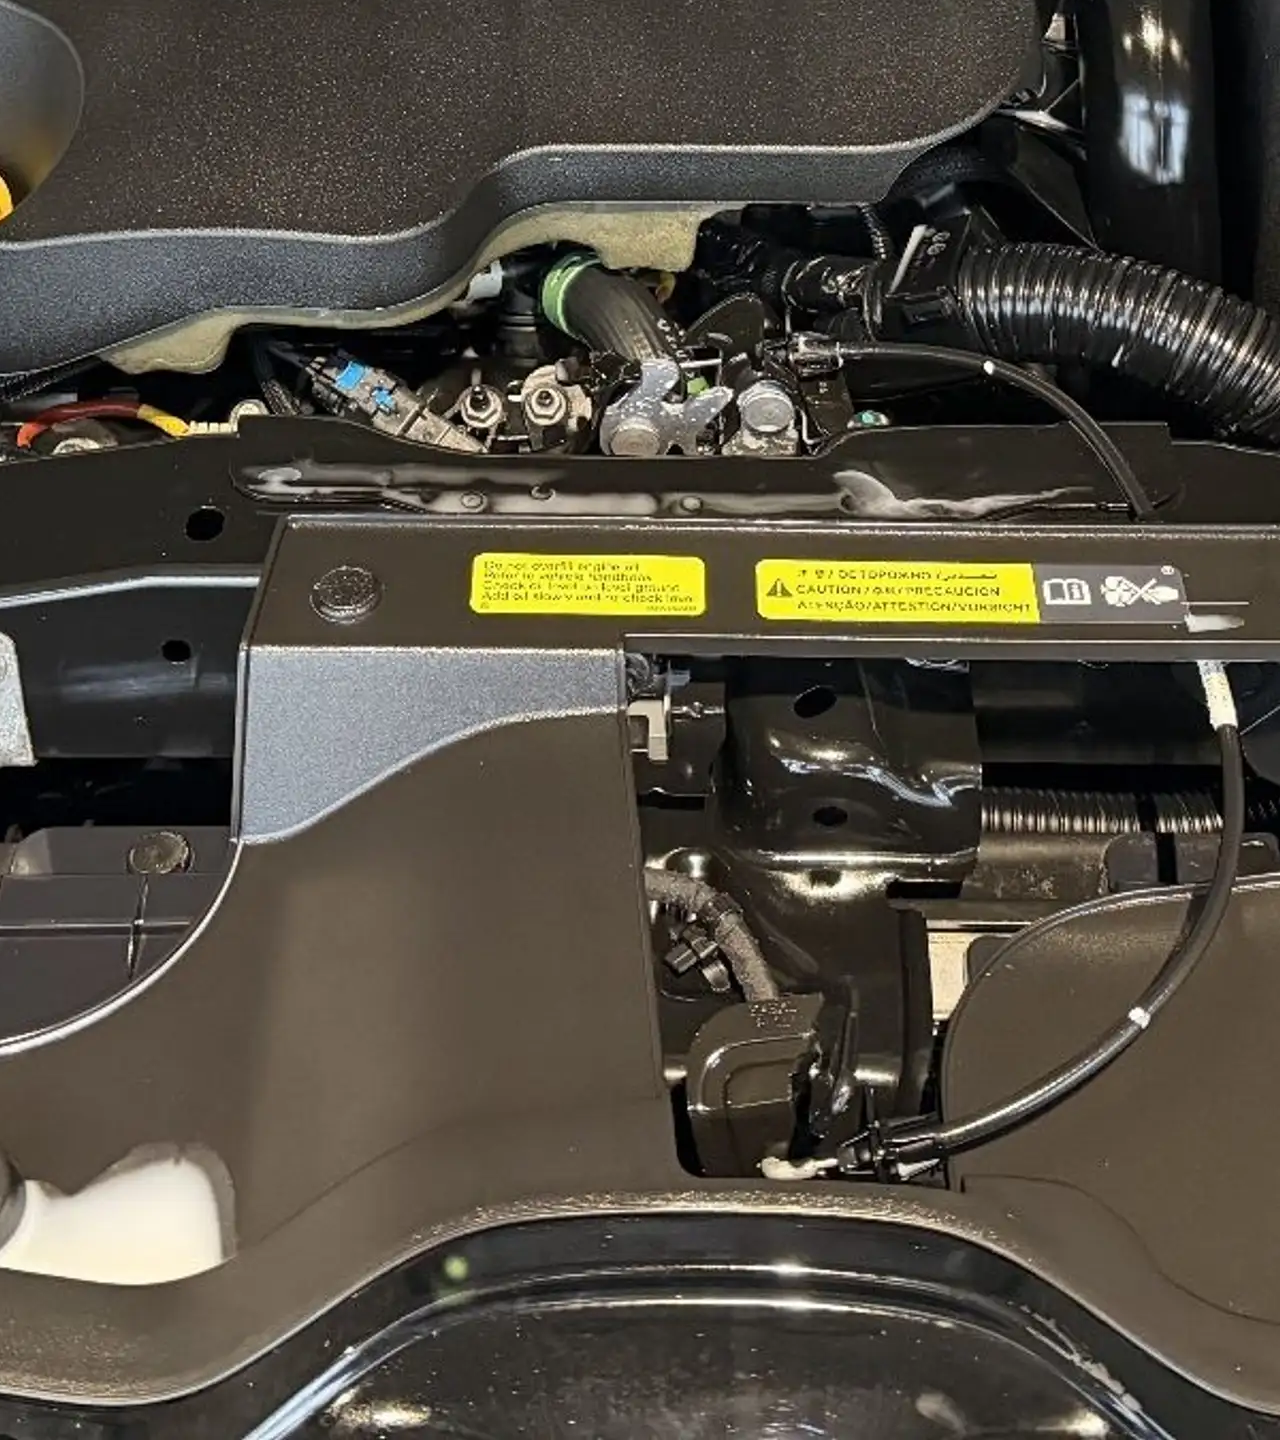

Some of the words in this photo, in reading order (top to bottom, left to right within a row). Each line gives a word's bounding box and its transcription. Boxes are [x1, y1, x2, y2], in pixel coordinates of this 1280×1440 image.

[483, 580, 524, 591] Check
[795, 584, 861, 595] CAUTION
[482, 591, 509, 601] Add
